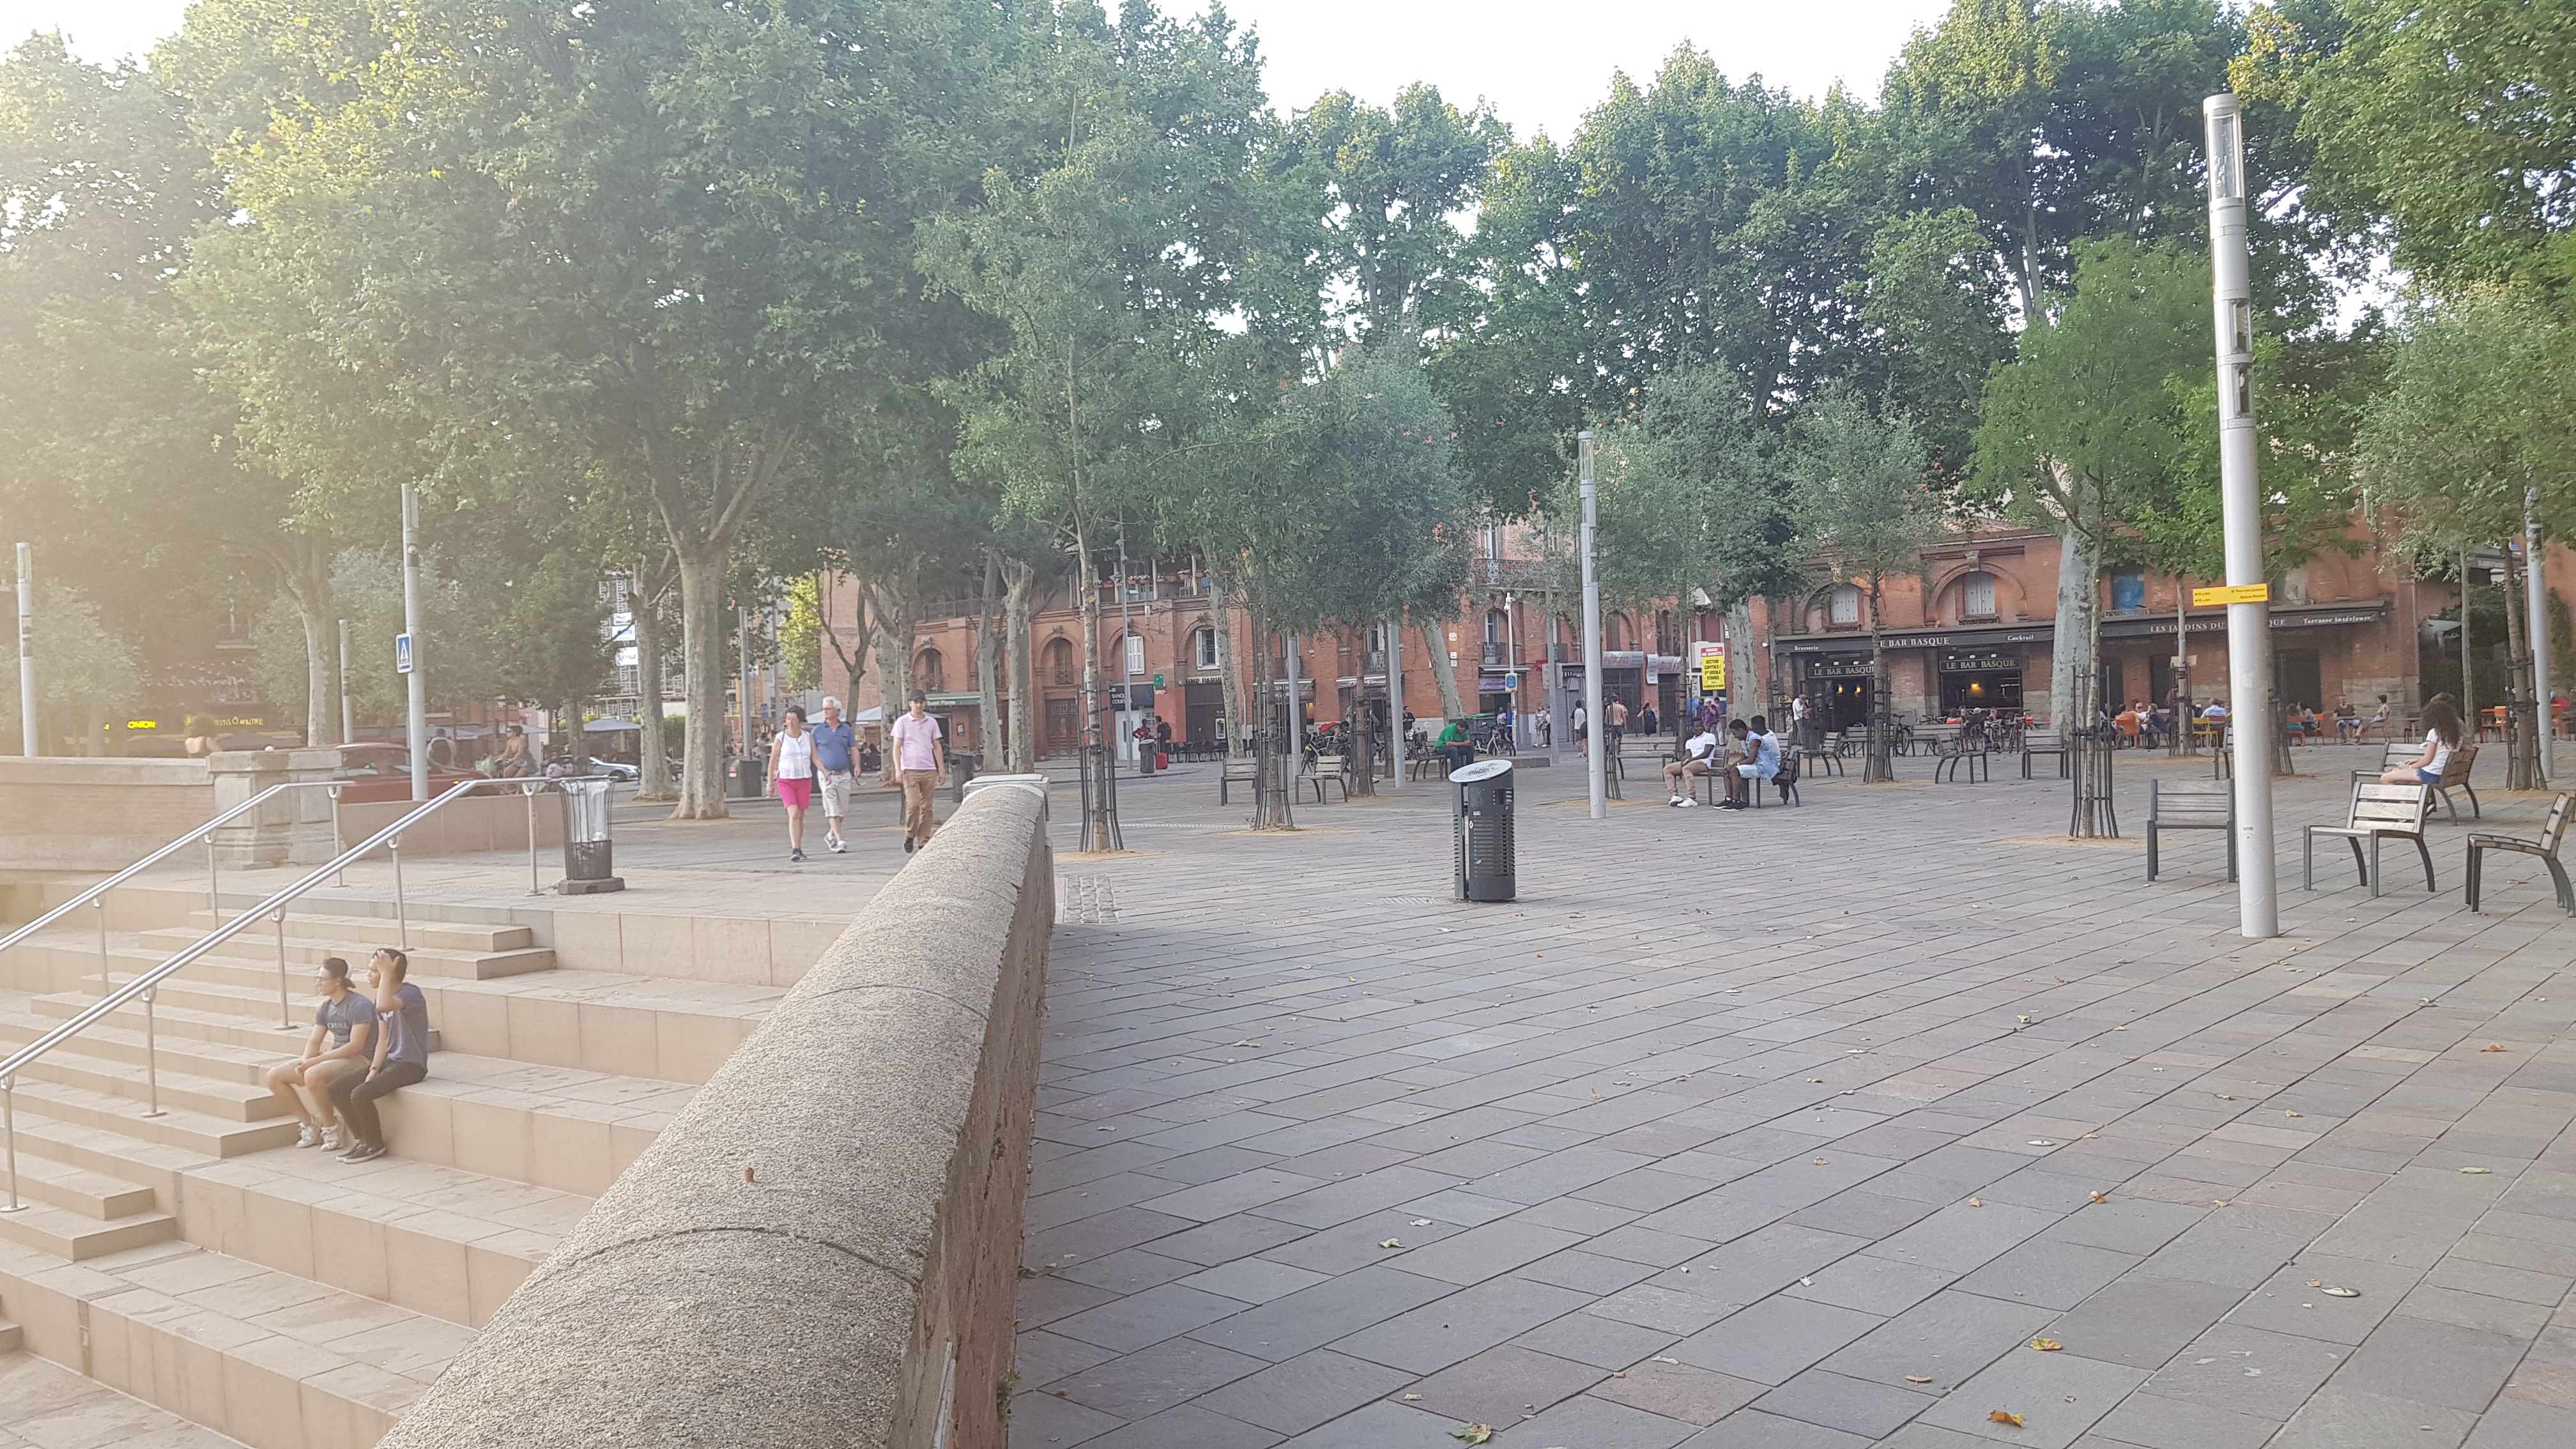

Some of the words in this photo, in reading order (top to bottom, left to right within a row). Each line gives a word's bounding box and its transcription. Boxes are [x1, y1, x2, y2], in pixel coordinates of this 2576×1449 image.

[2168, 623, 2207, 632] JADINS
[1910, 638, 1949, 646] BASQUE
[1981, 659, 2015, 668] BASQUE
